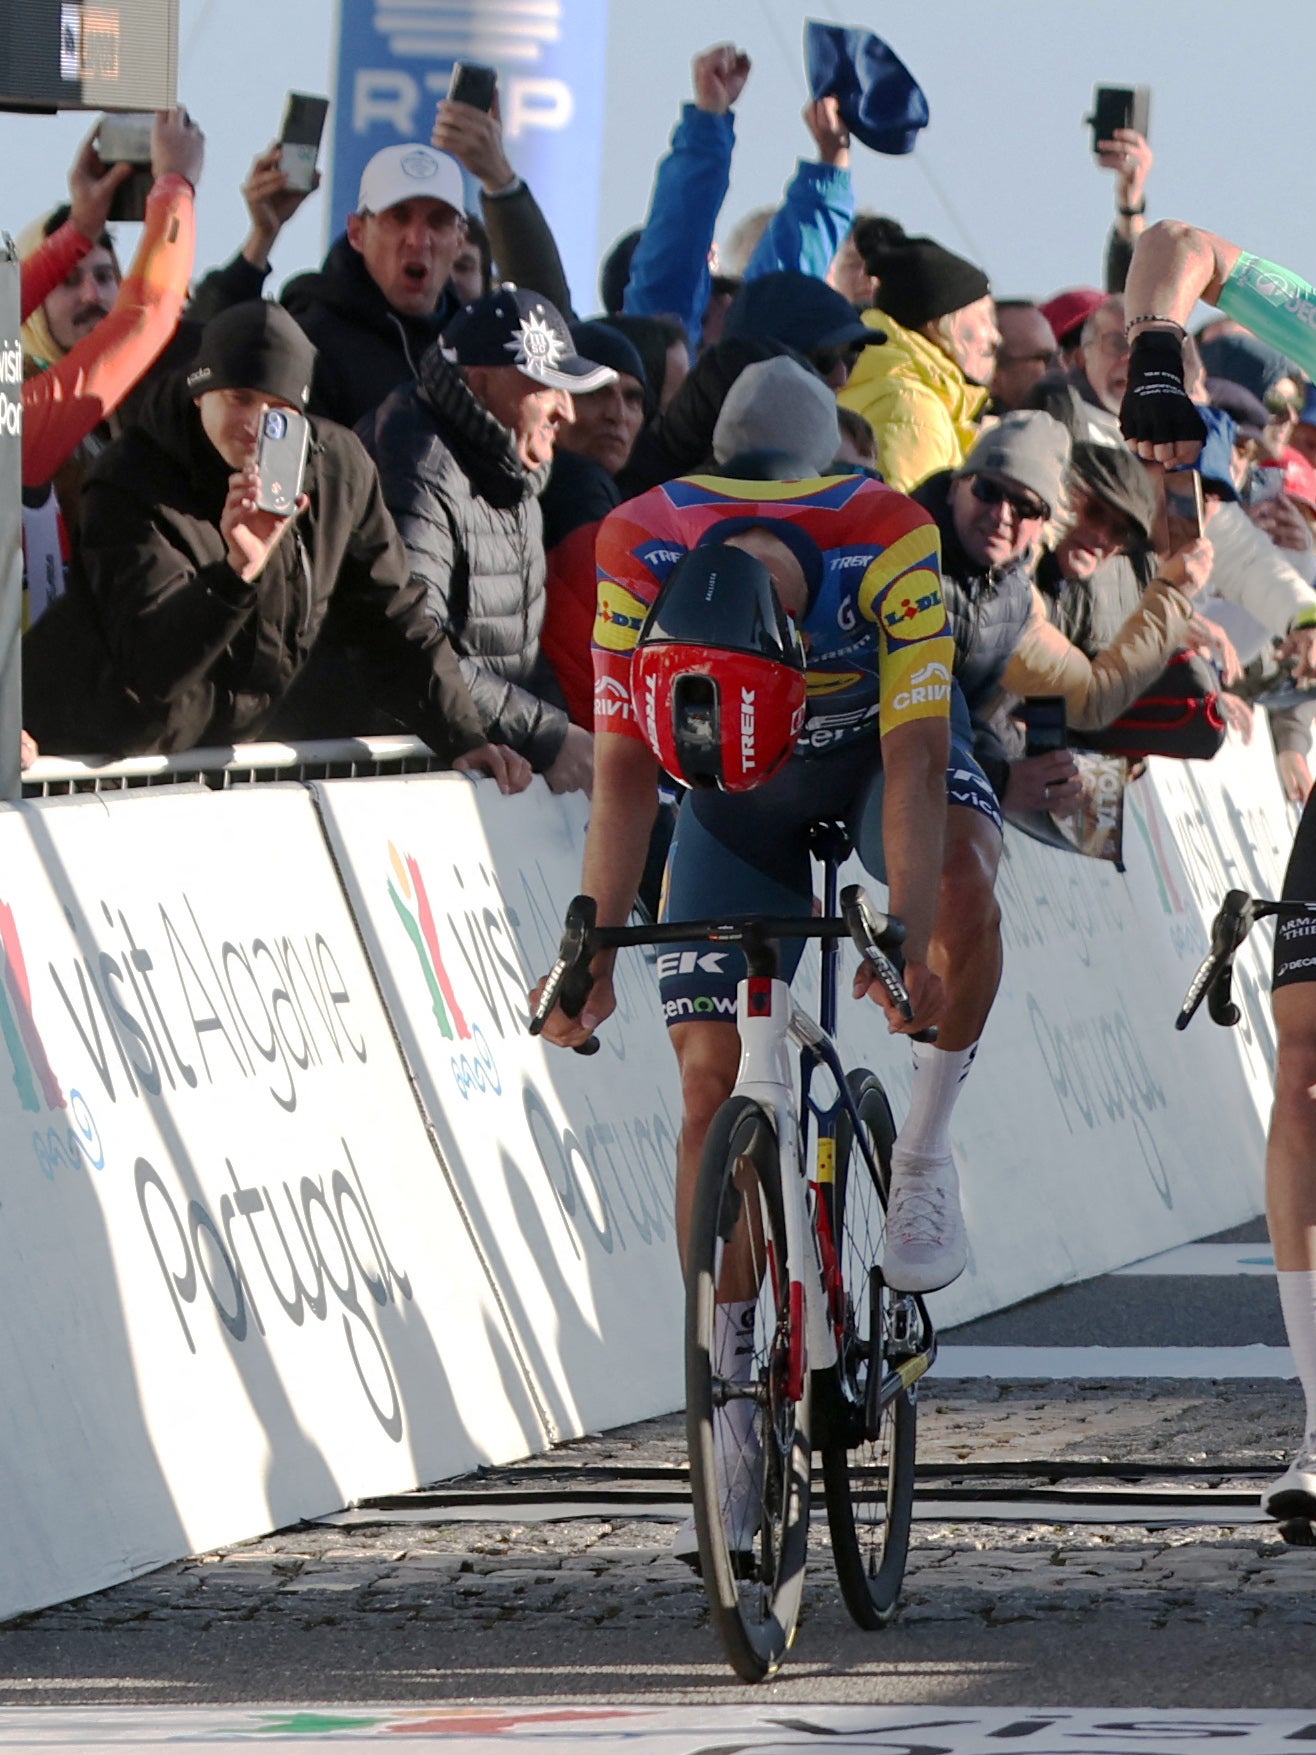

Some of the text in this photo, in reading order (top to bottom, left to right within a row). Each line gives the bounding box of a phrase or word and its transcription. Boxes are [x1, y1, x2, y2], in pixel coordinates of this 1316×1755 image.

[353, 68, 573, 138] RP
[830, 555, 874, 571] TREK
[742, 687, 756, 773] TREK
[49, 899, 198, 1103] visit
[160, 892, 367, 1113] Algarve
[134, 1136, 413, 1442] Portugal
